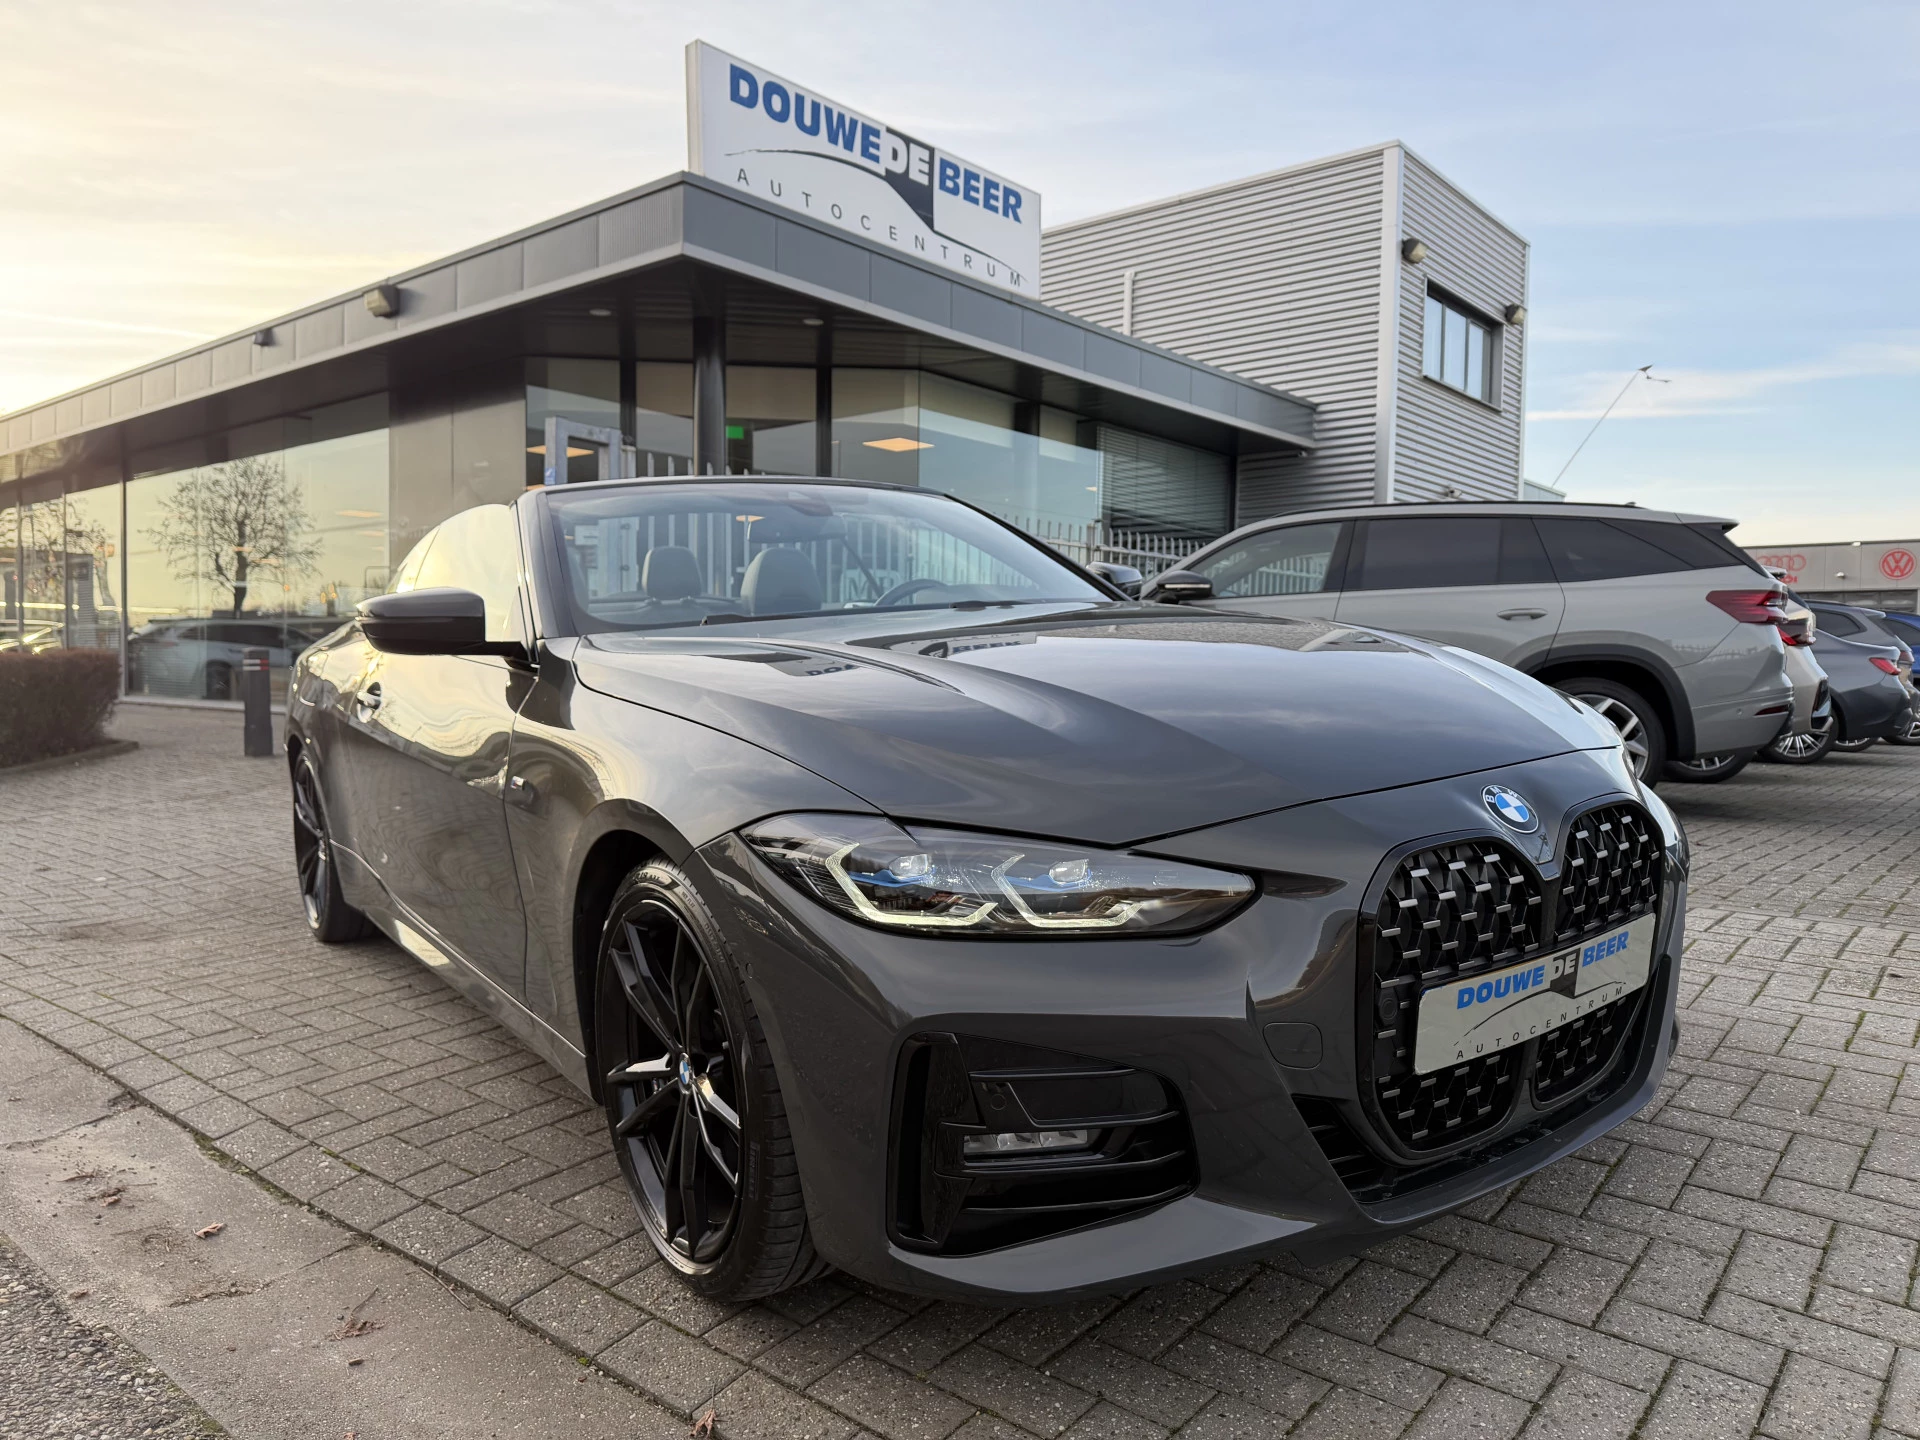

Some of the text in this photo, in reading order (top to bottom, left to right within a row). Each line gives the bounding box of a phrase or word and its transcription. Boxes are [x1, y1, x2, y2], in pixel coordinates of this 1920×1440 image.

[729, 62, 1023, 225] DOUWE DE BEER
[737, 167, 1021, 288] AUTOCENTRUM
[1456, 931, 1630, 1010] DOUWE DE BEER
[1456, 986, 1623, 1061] AUTOCENTRUM
